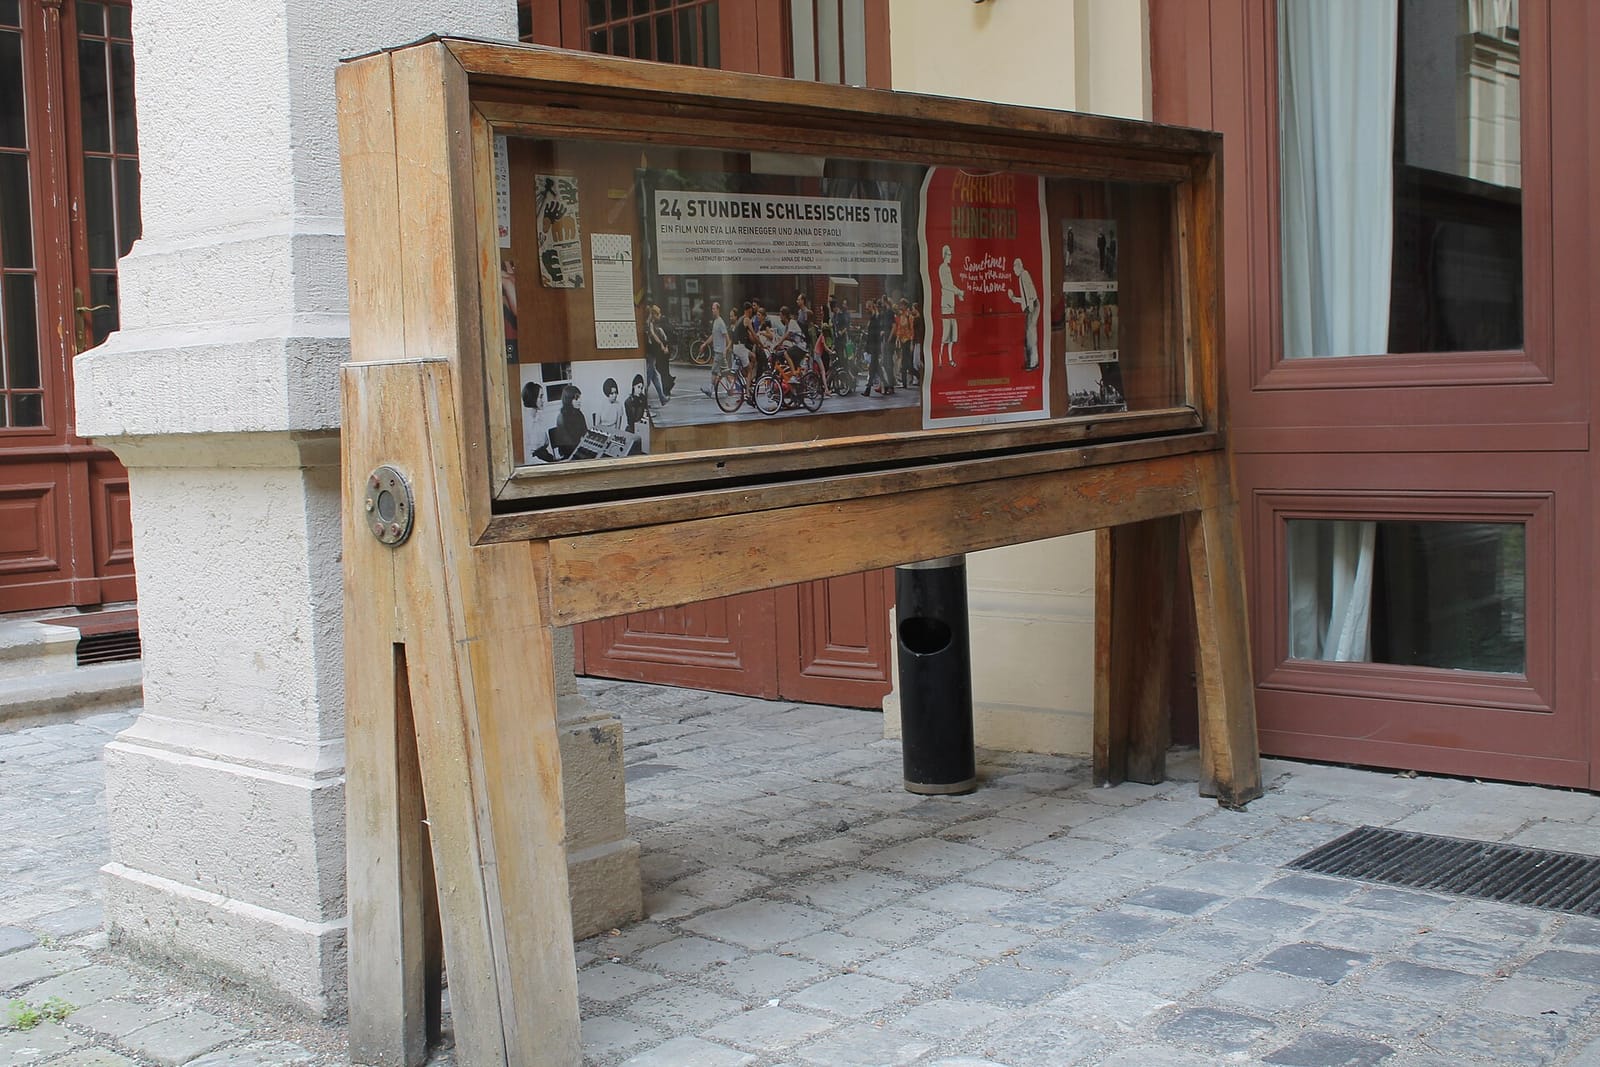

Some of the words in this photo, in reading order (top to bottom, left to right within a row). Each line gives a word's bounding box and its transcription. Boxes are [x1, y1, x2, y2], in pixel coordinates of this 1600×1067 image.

[660, 198, 682, 220] 24
[687, 199, 762, 219] STUNDEN
[766, 202, 870, 222] SCHLESISCHES
[874, 207, 898, 223] TOR
[661, 225, 673, 233] EIN
[675, 225, 692, 233] FILM
[693, 225, 709, 234] VON
[710, 225, 723, 234] EVA
[725, 226, 737, 234] LIA
[738, 226, 776, 235] REINEGGER
[779, 227, 792, 235] UND
[794, 227, 812, 236] ANNA
[813, 228, 822, 236] DE
[823, 228, 841, 237] PAOLI
[964, 252, 1006, 271] Sometimes
[983, 279, 1006, 294] home
